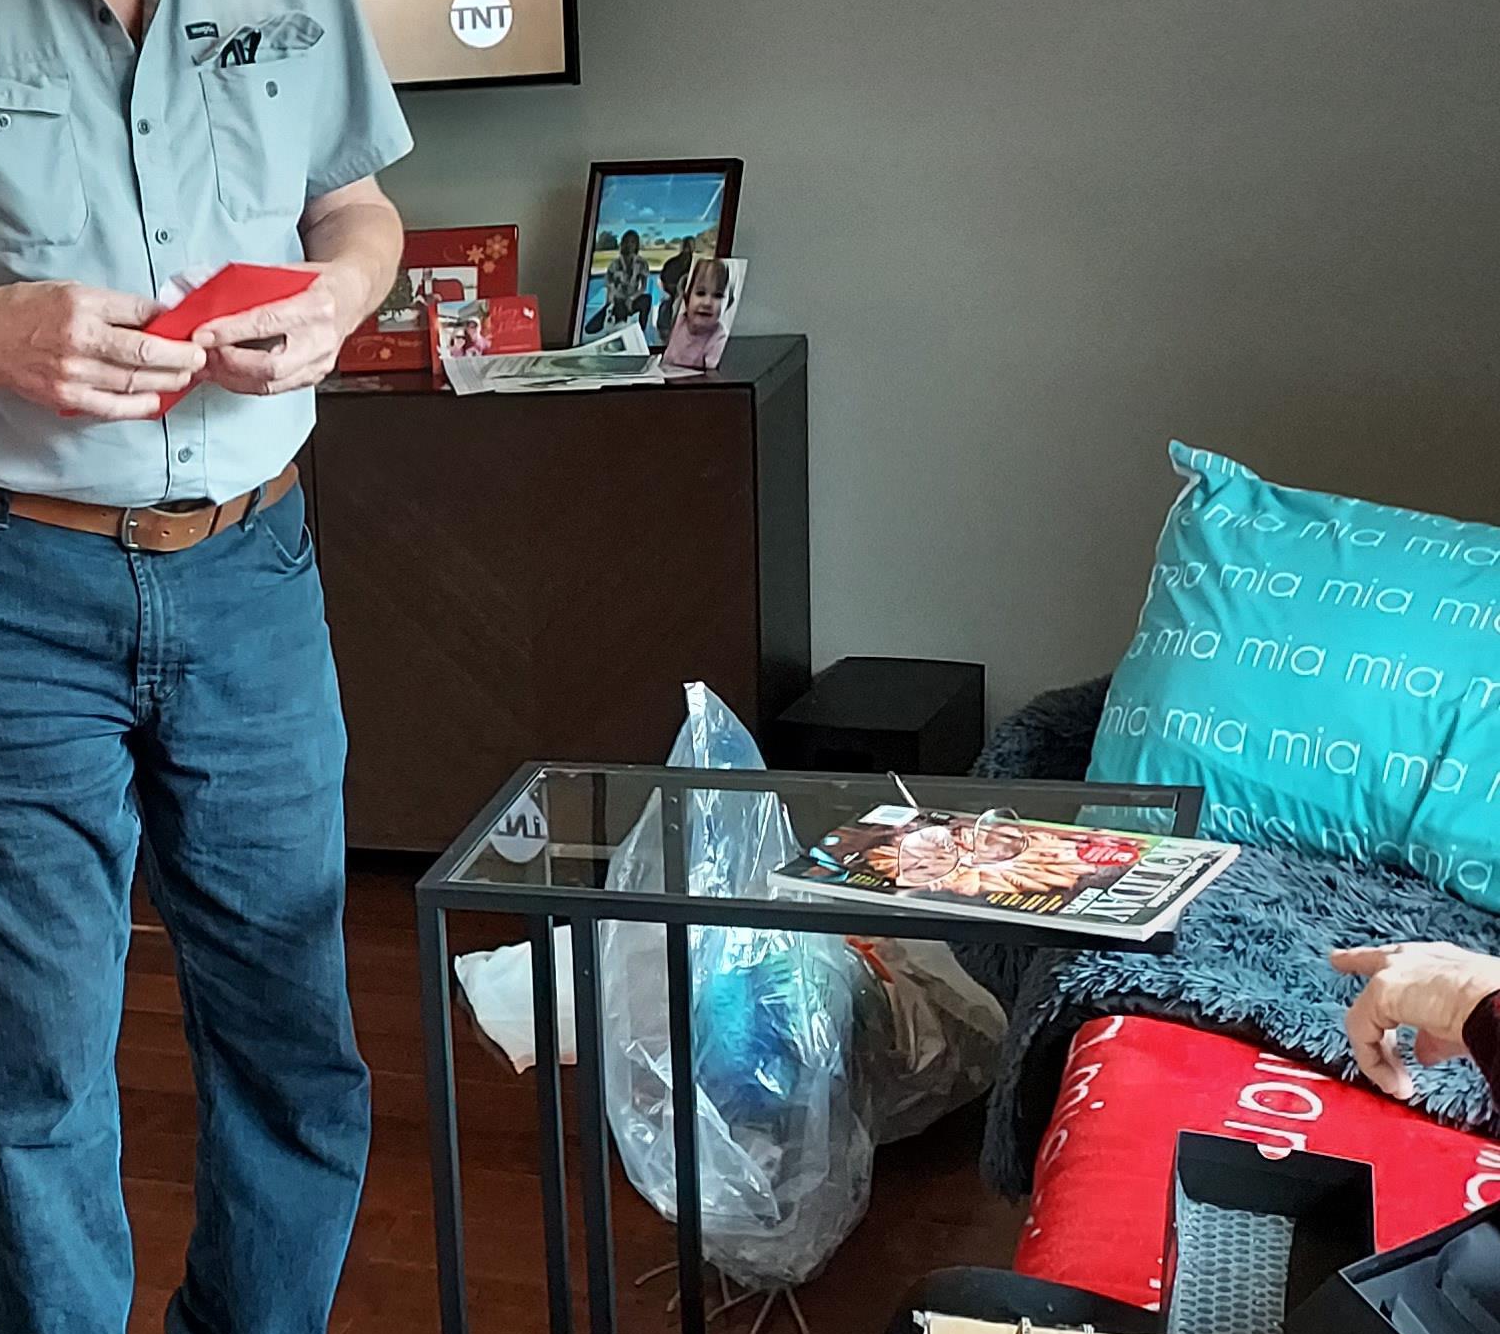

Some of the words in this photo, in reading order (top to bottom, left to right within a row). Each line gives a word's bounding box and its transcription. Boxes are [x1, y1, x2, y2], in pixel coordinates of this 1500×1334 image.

[451, 4, 512, 30] TNT
[1203, 503, 1287, 532] mia
[1300, 517, 1386, 548] mia
[1219, 562, 1303, 598] mia
[1317, 578, 1413, 615] mia
[1432, 597, 1500, 631] mi
[1151, 620, 1221, 659] mia
[1236, 633, 1326, 677] mia
[1345, 653, 1444, 698] mia
[1162, 706, 1248, 755] mia
[1267, 726, 1361, 776] mia
[1408, 843, 1493, 894] mia
